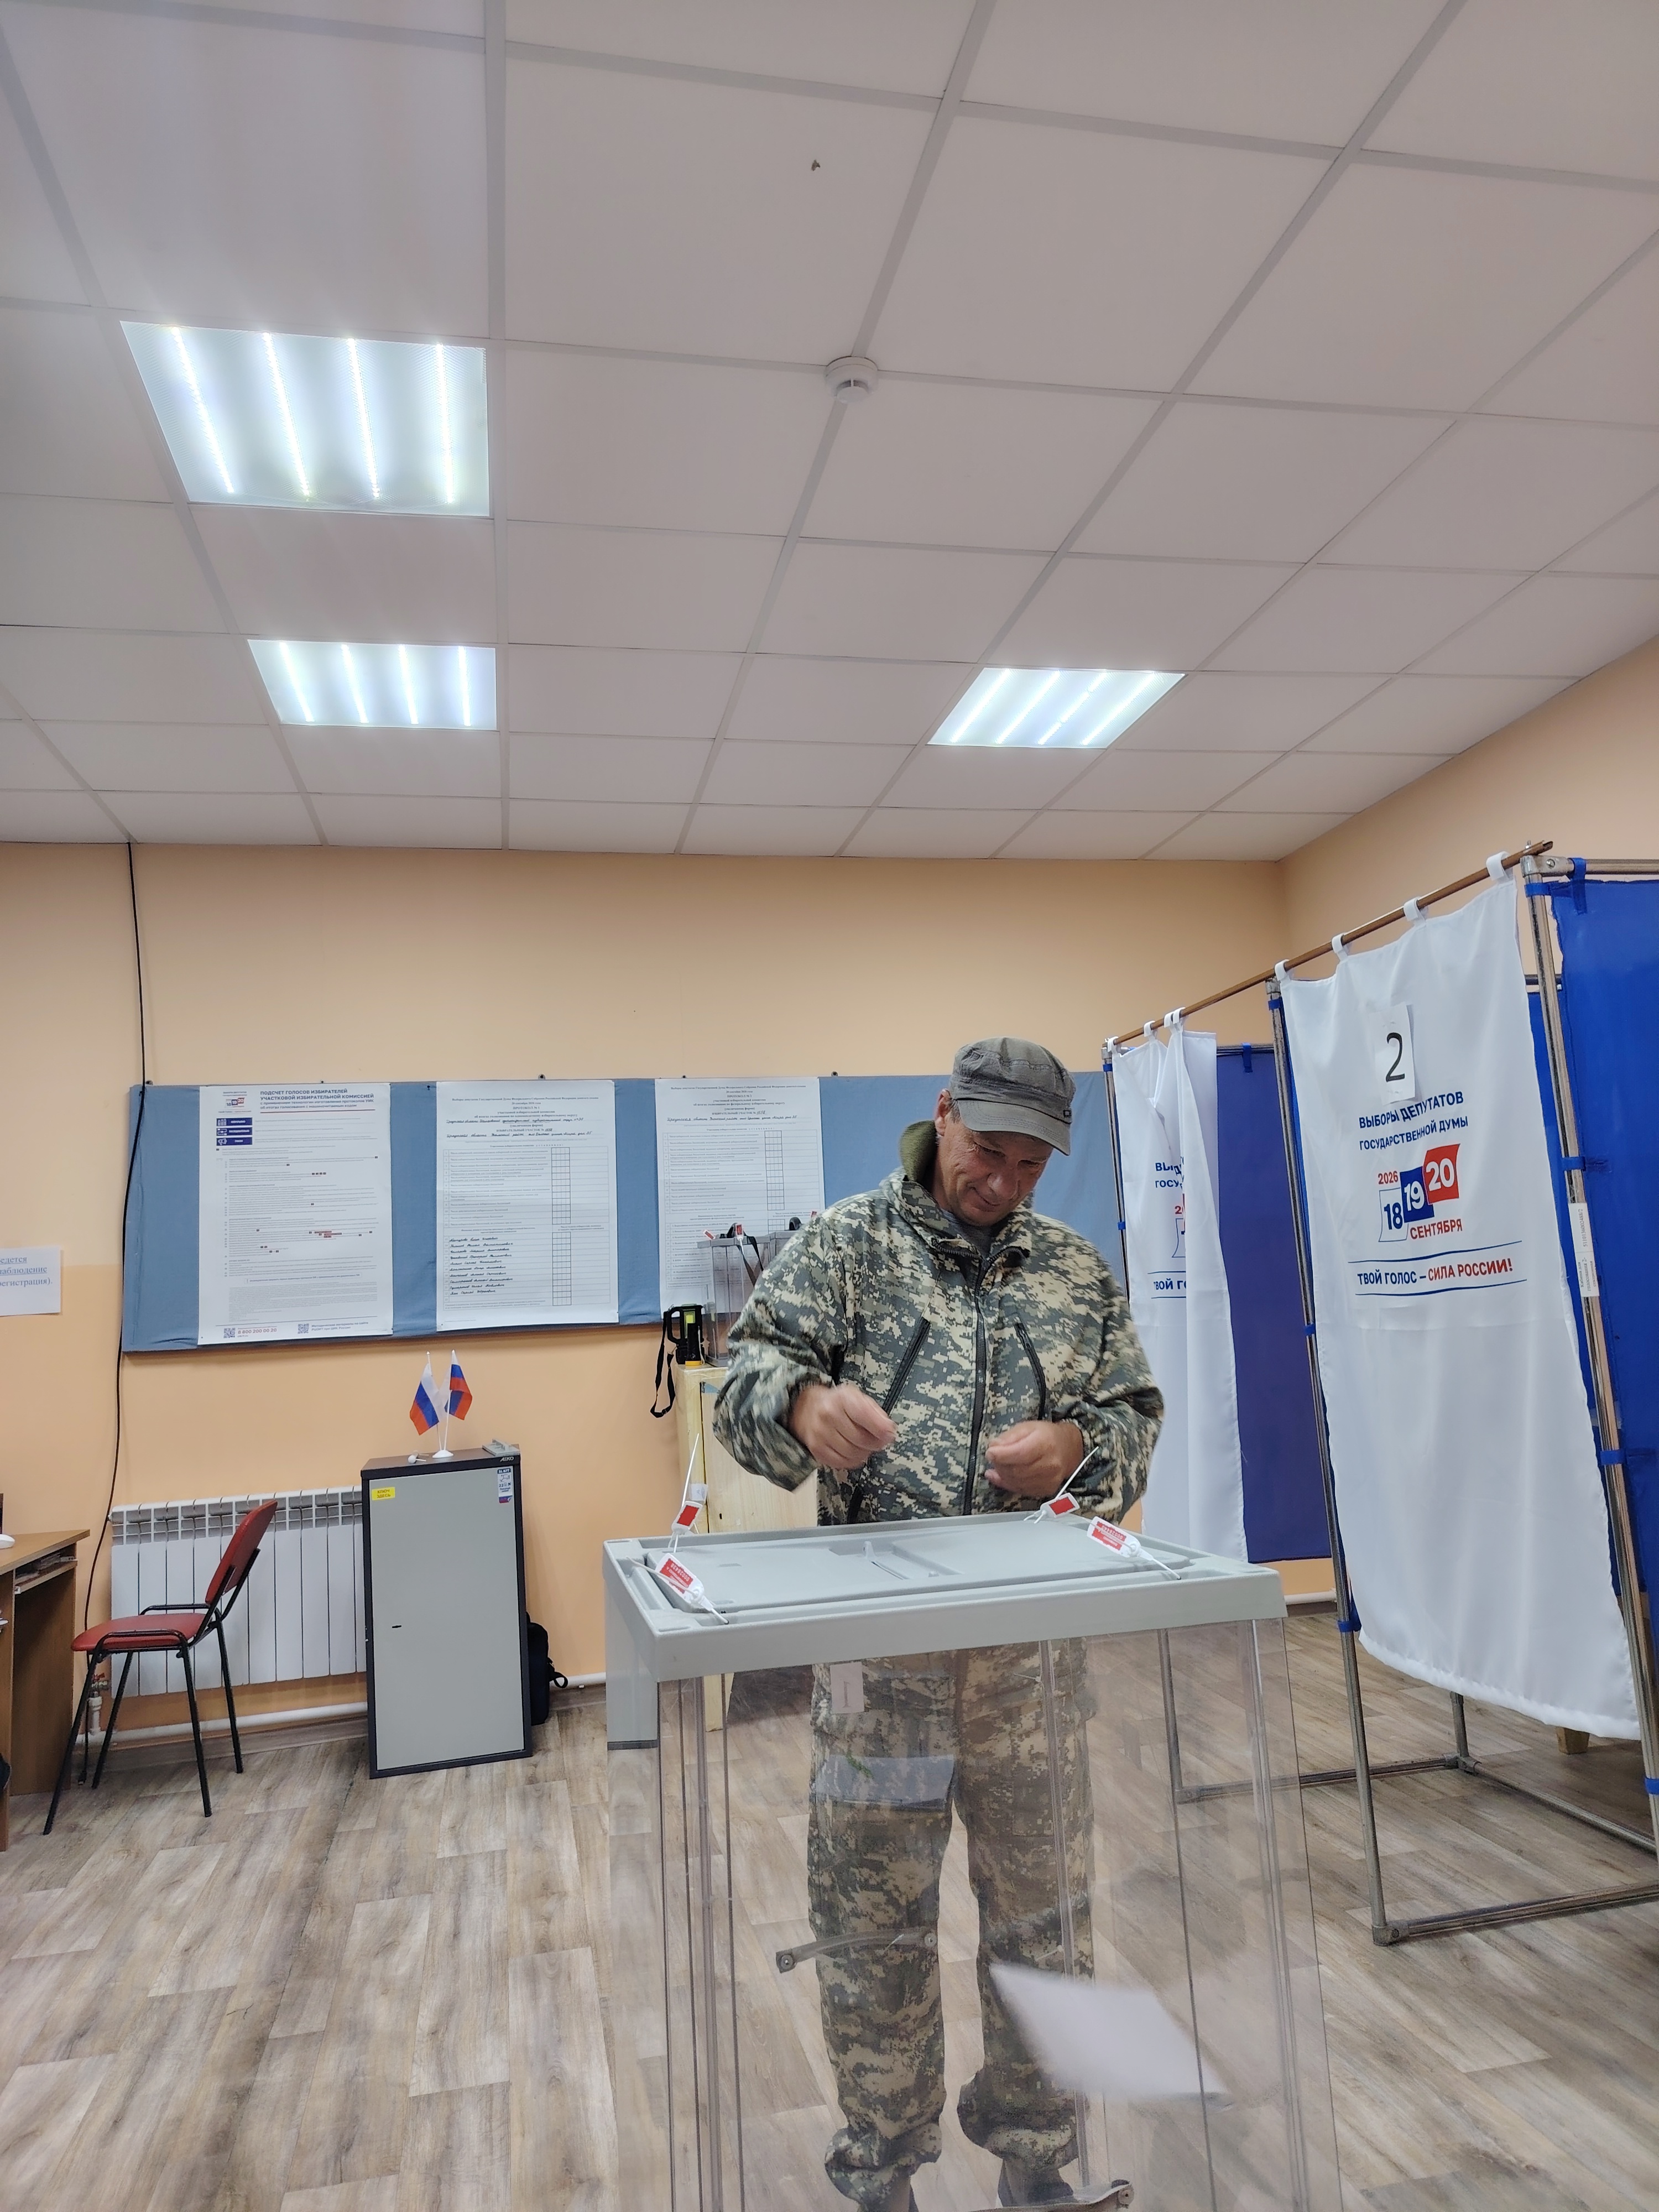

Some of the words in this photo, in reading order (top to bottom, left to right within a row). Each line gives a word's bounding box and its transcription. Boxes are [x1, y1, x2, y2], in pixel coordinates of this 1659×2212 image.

[1385, 1032, 1405, 1082] 2
[1359, 1110, 1400, 1129] ВЫБОРЫ
[1400, 1091, 1464, 1122] ДЕПУТАТОВ
[1359, 1119, 1437, 1150] ГОСУДАРСТВЕННОЙ
[1439, 1116, 1468, 1133] ДУМЫ
[1155, 1180, 1179, 1188] ГОСУ
[1378, 1171, 1399, 1185] 2026
[1426, 1158, 1455, 1192] 20
[1175, 1206, 1185, 1214] 2
[1404, 1181, 1425, 1212] 19
[1384, 1202, 1403, 1230] 18
[1410, 1219, 1463, 1240] СЕНТЯБРЯ
[1357, 1269, 1383, 1285] ТВОЙ
[1385, 1271, 1417, 1285] ГОЛОС
[1428, 1265, 1455, 1281] СИЛА
[1457, 1258, 1513, 1277] РОССИИ!
